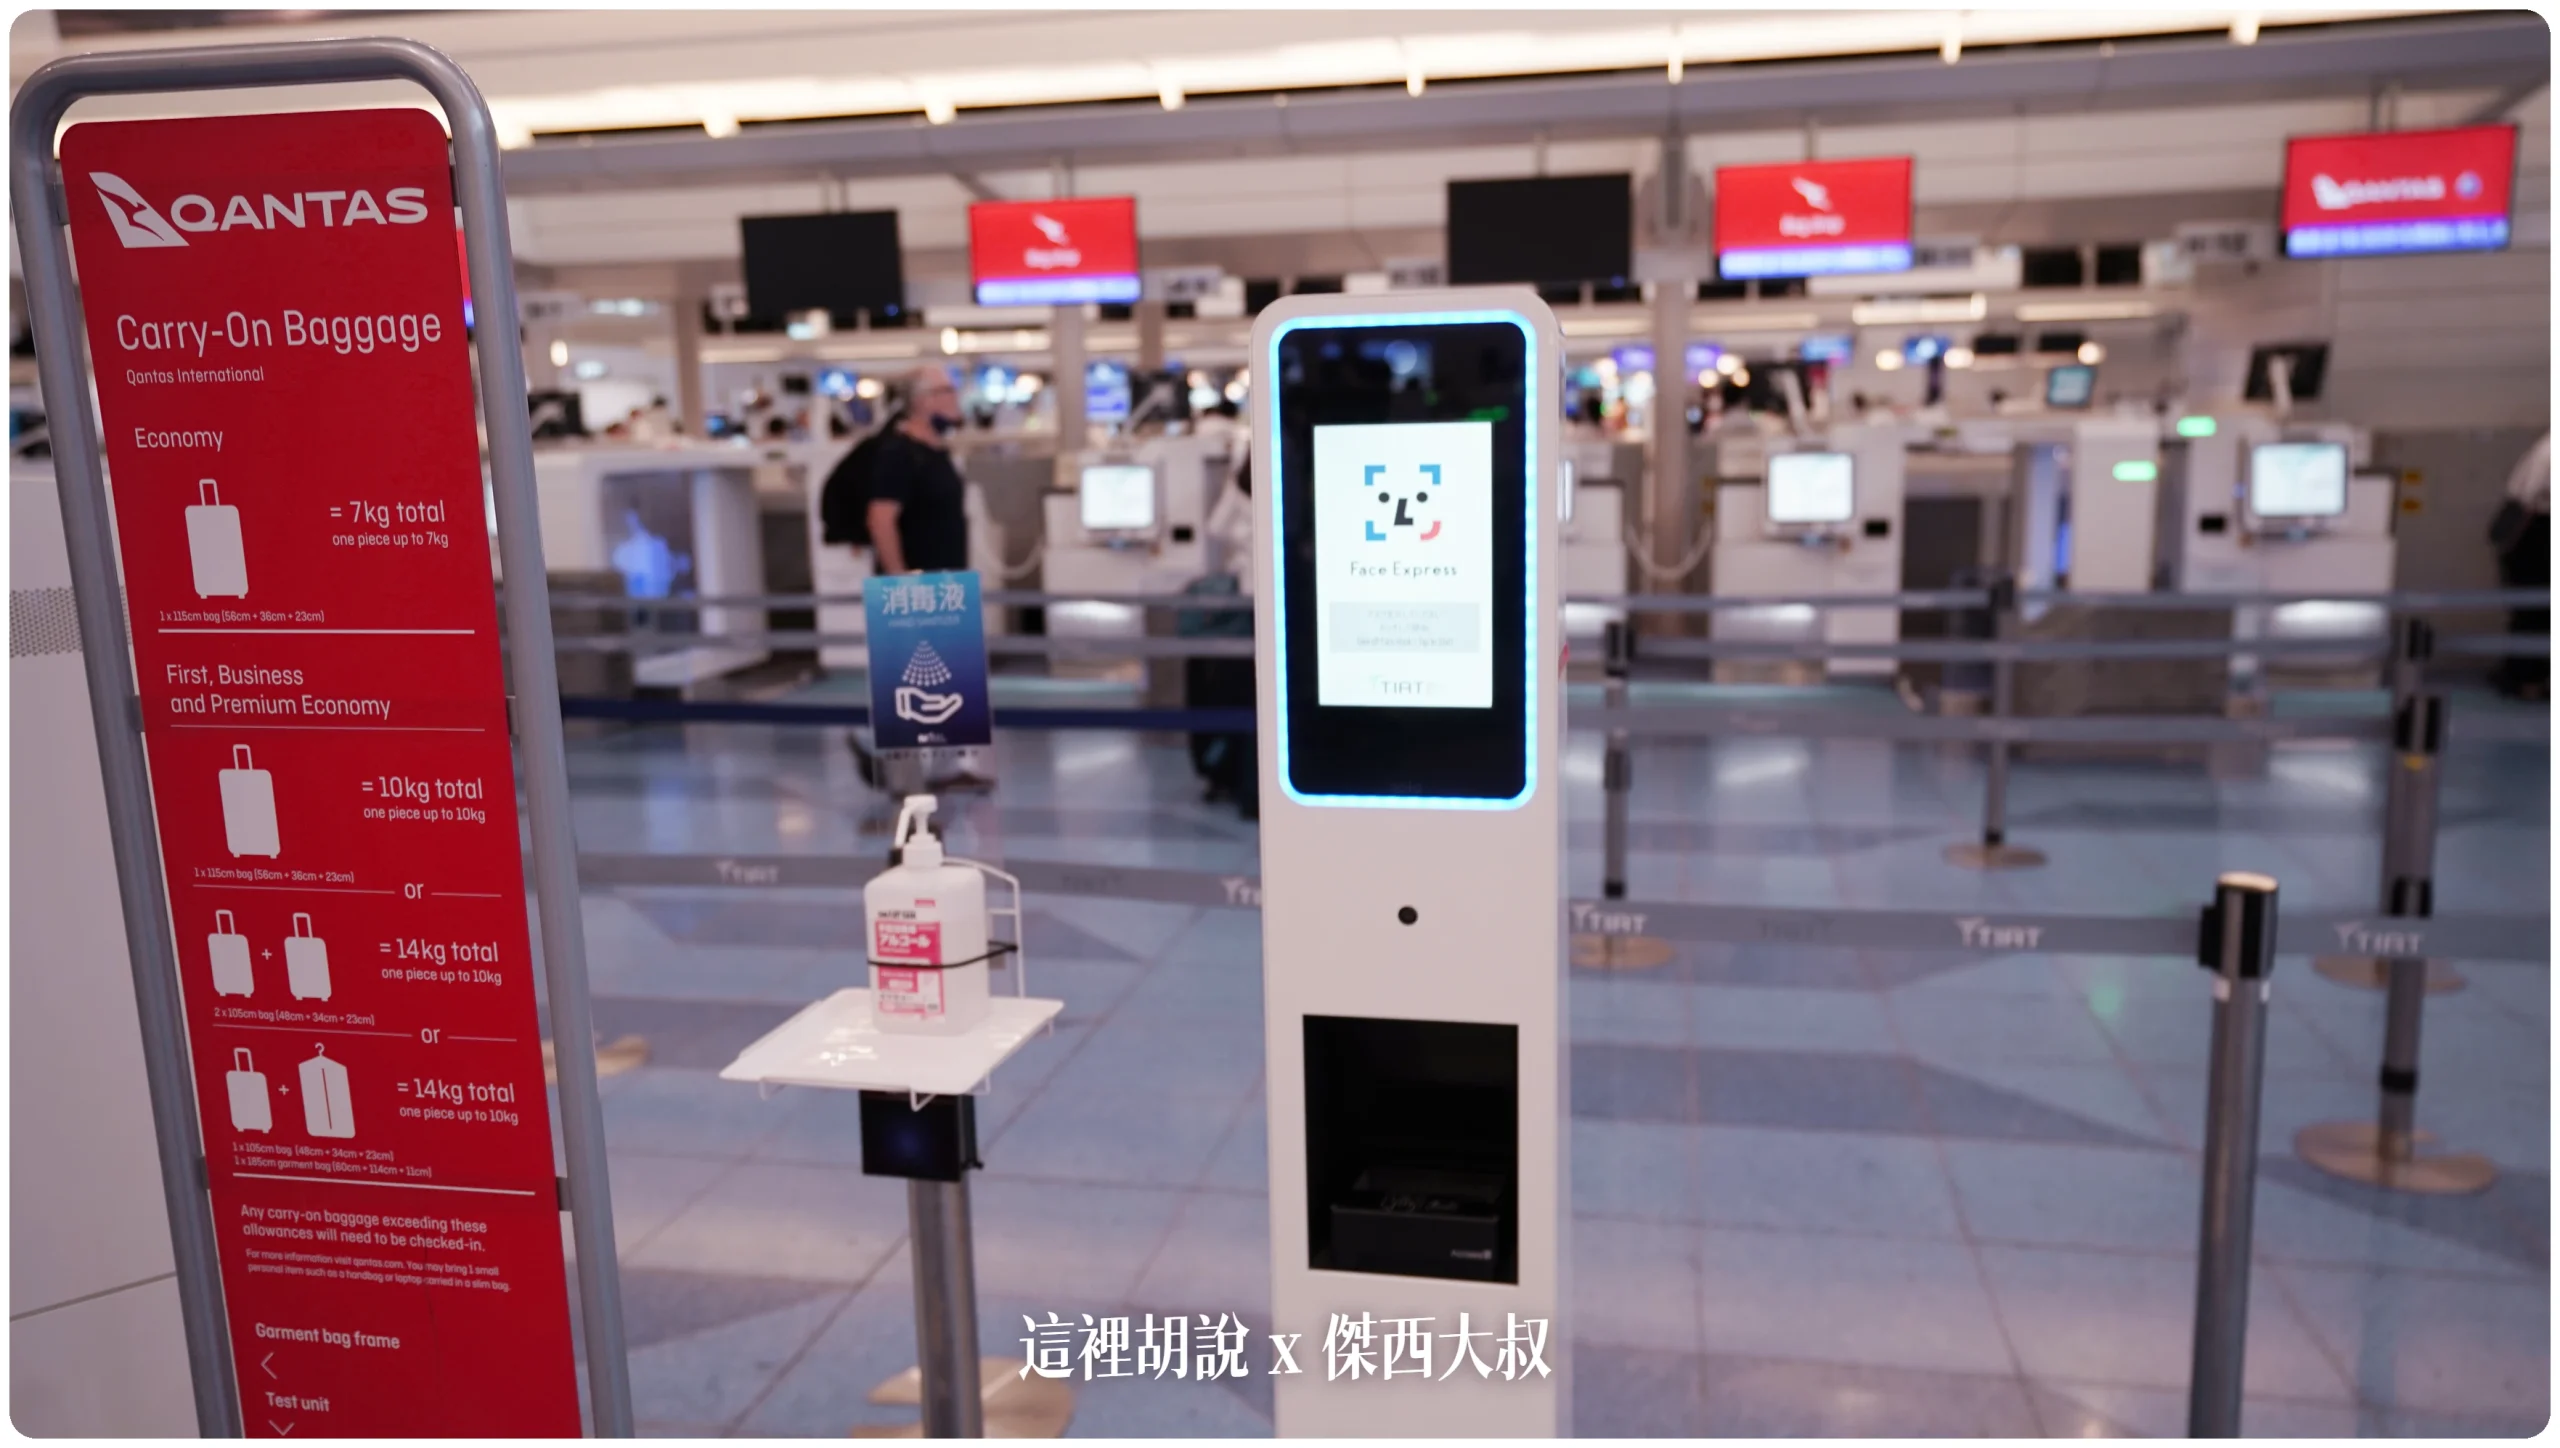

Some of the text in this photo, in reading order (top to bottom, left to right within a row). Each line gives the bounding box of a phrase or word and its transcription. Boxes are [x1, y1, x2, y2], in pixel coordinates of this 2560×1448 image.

[170, 188, 428, 231] QANTAS
[117, 310, 441, 357] Carry-On Baggage
[127, 366, 264, 386] Qantas International
[135, 428, 222, 452] Economy
[350, 501, 389, 528] 7kg
[396, 500, 444, 522] total
[333, 532, 448, 548] one piece up to 7kg
[1351, 561, 1457, 579] Face Express
[882, 581, 966, 615] 消毒液
[167, 664, 303, 686] First, Business
[171, 694, 390, 720] and Premium Economy
[379, 776, 429, 803] 10kg
[435, 778, 482, 799] total
[364, 806, 485, 824] one piece up to 10kg
[405, 883, 423, 899] or
[397, 938, 446, 965] 14kg
[451, 942, 498, 962] total
[382, 968, 502, 986] one piece up to 10kg
[421, 1028, 440, 1043] or
[414, 1078, 463, 1105] 14kg
[468, 1083, 514, 1102] total
[400, 1107, 518, 1126] one piece up to 10kg
[241, 1204, 487, 1234] Any carry-on baggage exceeding these
[243, 1221, 485, 1251] allowances will need to be checked-in.
[245, 1248, 260, 1258] For
[261, 1251, 284, 1260] more
[284, 1252, 334, 1264] information
[334, 1256, 352, 1266] visit
[406, 1260, 424, 1271] You
[424, 1263, 444, 1274] may
[444, 1263, 468, 1276] bring
[468, 1264, 474, 1275] 1
[475, 1266, 500, 1276] small
[248, 1263, 283, 1275] personal
[284, 1265, 304, 1275] item
[305, 1266, 326, 1277] such
[327, 1269, 338, 1278] as
[338, 1270, 345, 1279] a
[346, 1269, 384, 1284] handbag
[384, 1274, 393, 1282] or
[394, 1272, 423, 1287] laptop
[454, 1278, 464, 1288] in
[464, 1279, 471, 1288] a
[471, 1279, 491, 1290] slim
[491, 1280, 511, 1293] bag.
[256, 1323, 400, 1349] Garment bag frame
[266, 1392, 329, 1411] Test unit
